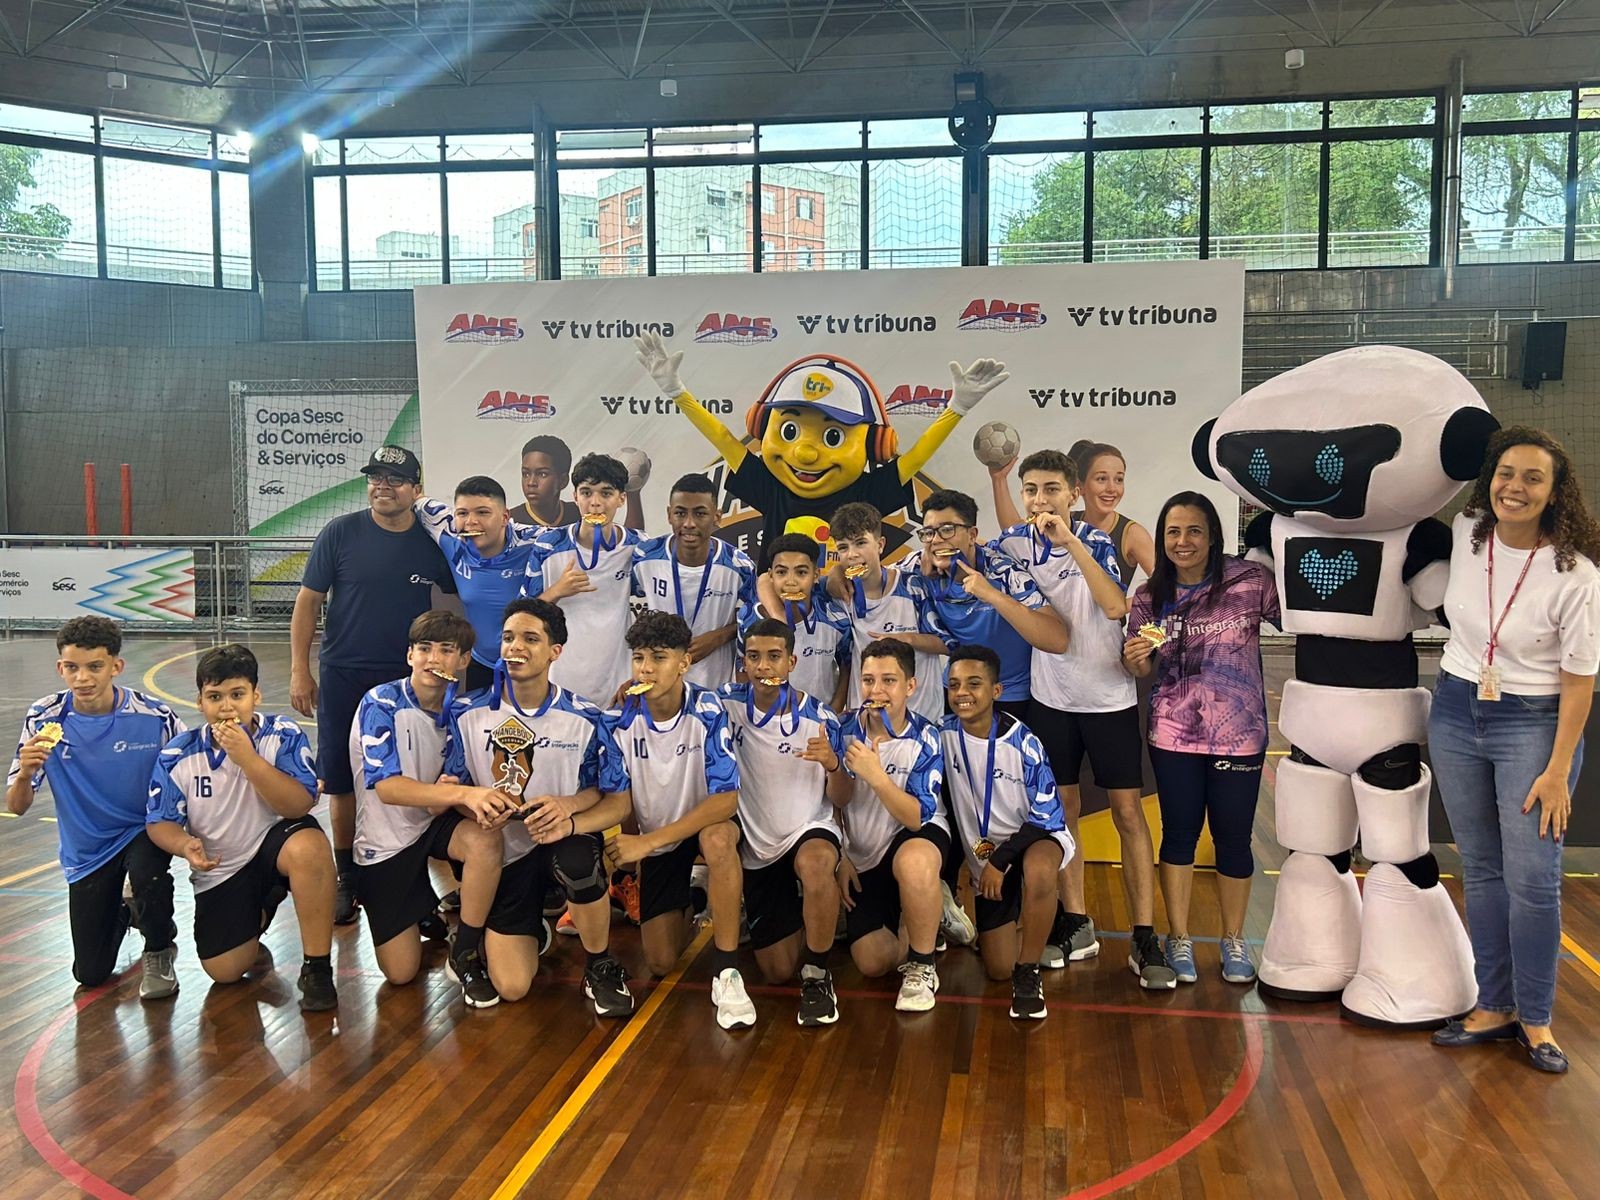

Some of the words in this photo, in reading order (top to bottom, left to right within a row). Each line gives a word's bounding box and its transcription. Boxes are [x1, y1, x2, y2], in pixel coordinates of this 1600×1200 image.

[826, 315, 850, 334] tv
[854, 313, 937, 333] tribuna
[1099, 306, 1124, 326] tv
[1128, 305, 1217, 325] tribuna
[570, 320, 592, 339] tv
[629, 396, 651, 415] tv
[1060, 388, 1085, 407] tv
[1089, 387, 1177, 407] tribuna
[256, 408, 300, 427] Copa
[303, 408, 344, 424] Sesc
[257, 429, 278, 445] do
[281, 428, 364, 444] Comércio
[258, 450, 270, 465] &
[273, 449, 346, 469] Serviços
[2, 570, 21, 578] Sesc
[652, 577, 667, 597] 19
[633, 738, 648, 759] 10
[194, 775, 213, 798] 16
